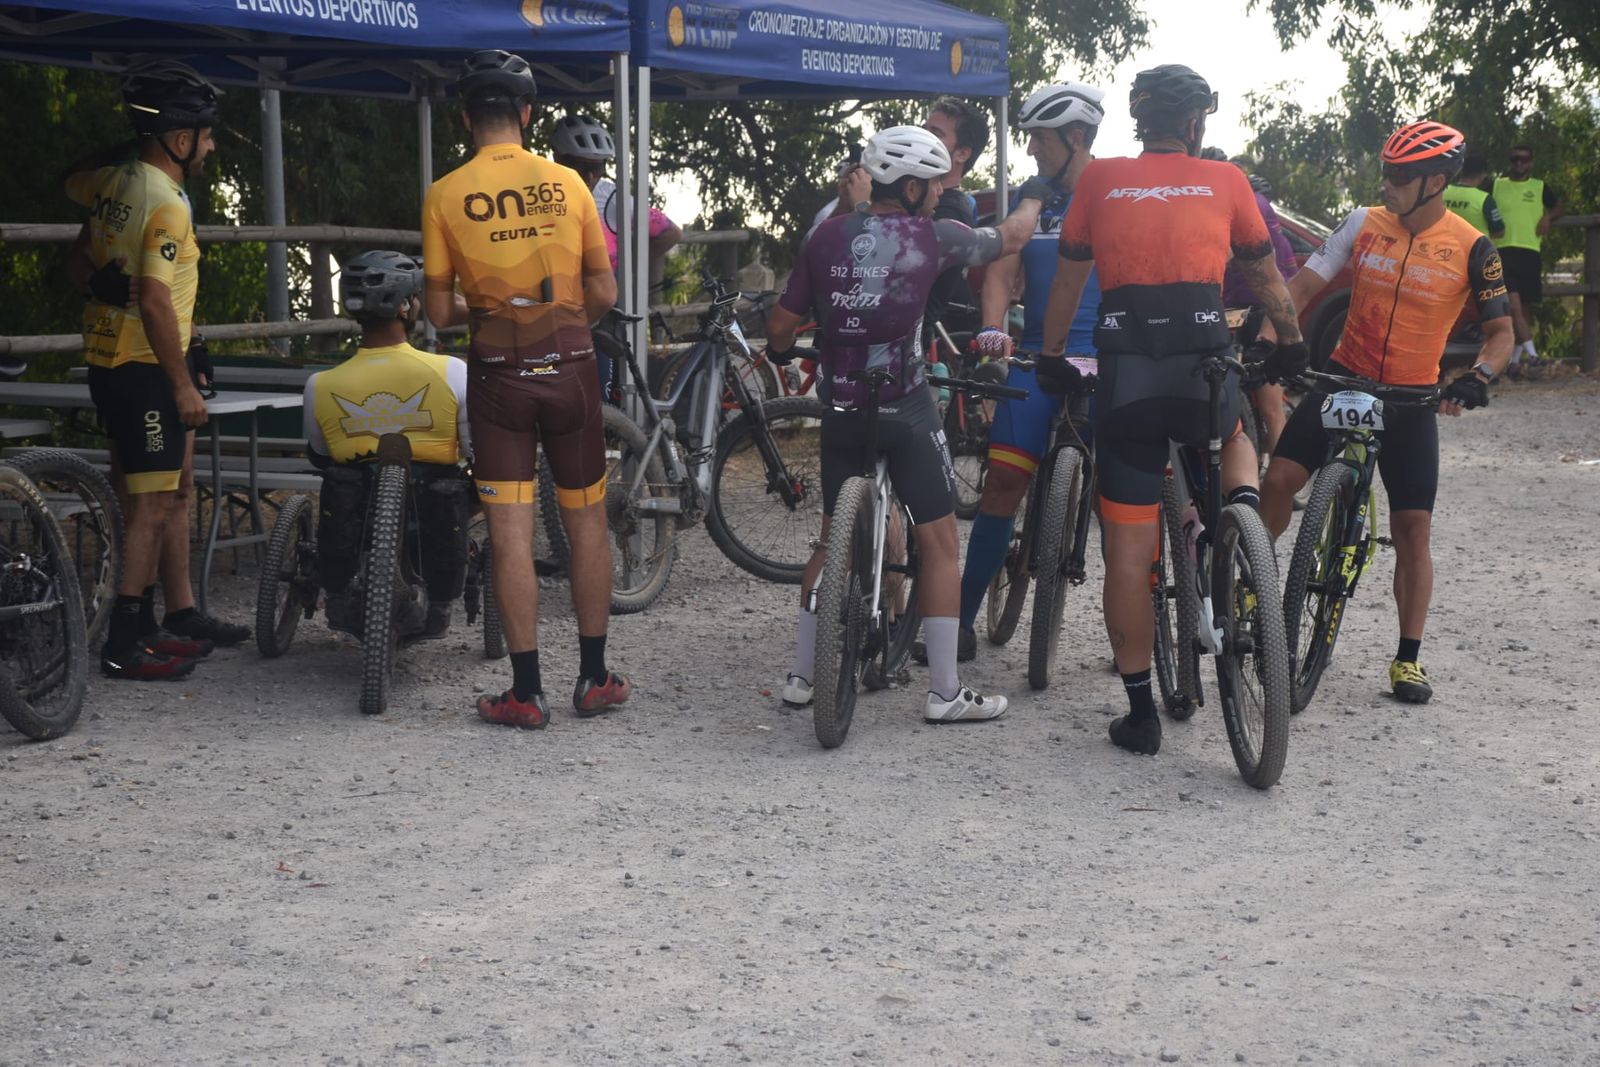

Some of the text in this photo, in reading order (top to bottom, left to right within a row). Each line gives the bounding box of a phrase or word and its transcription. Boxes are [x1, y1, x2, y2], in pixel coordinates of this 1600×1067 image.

[318, 0, 418, 30] DEPORTIVOS
[748, 10, 824, 39] CRONOMETRAJE
[826, 19, 888, 47] ORGANIZACIÓN
[896, 25, 930, 50] GESTIÓN
[930, 31, 942, 51] DE
[801, 49, 895, 76] EVENTOS DEPORTIVOS
[523, 182, 566, 206] 365
[527, 202, 567, 217] energy
[1445, 201, 1470, 209] TAFF
[490, 226, 538, 242] CEUTA
[830, 266, 890, 278] 512 BIKES
[831, 291, 881, 309] TRUFA
[1333, 407, 1375, 427] 194
